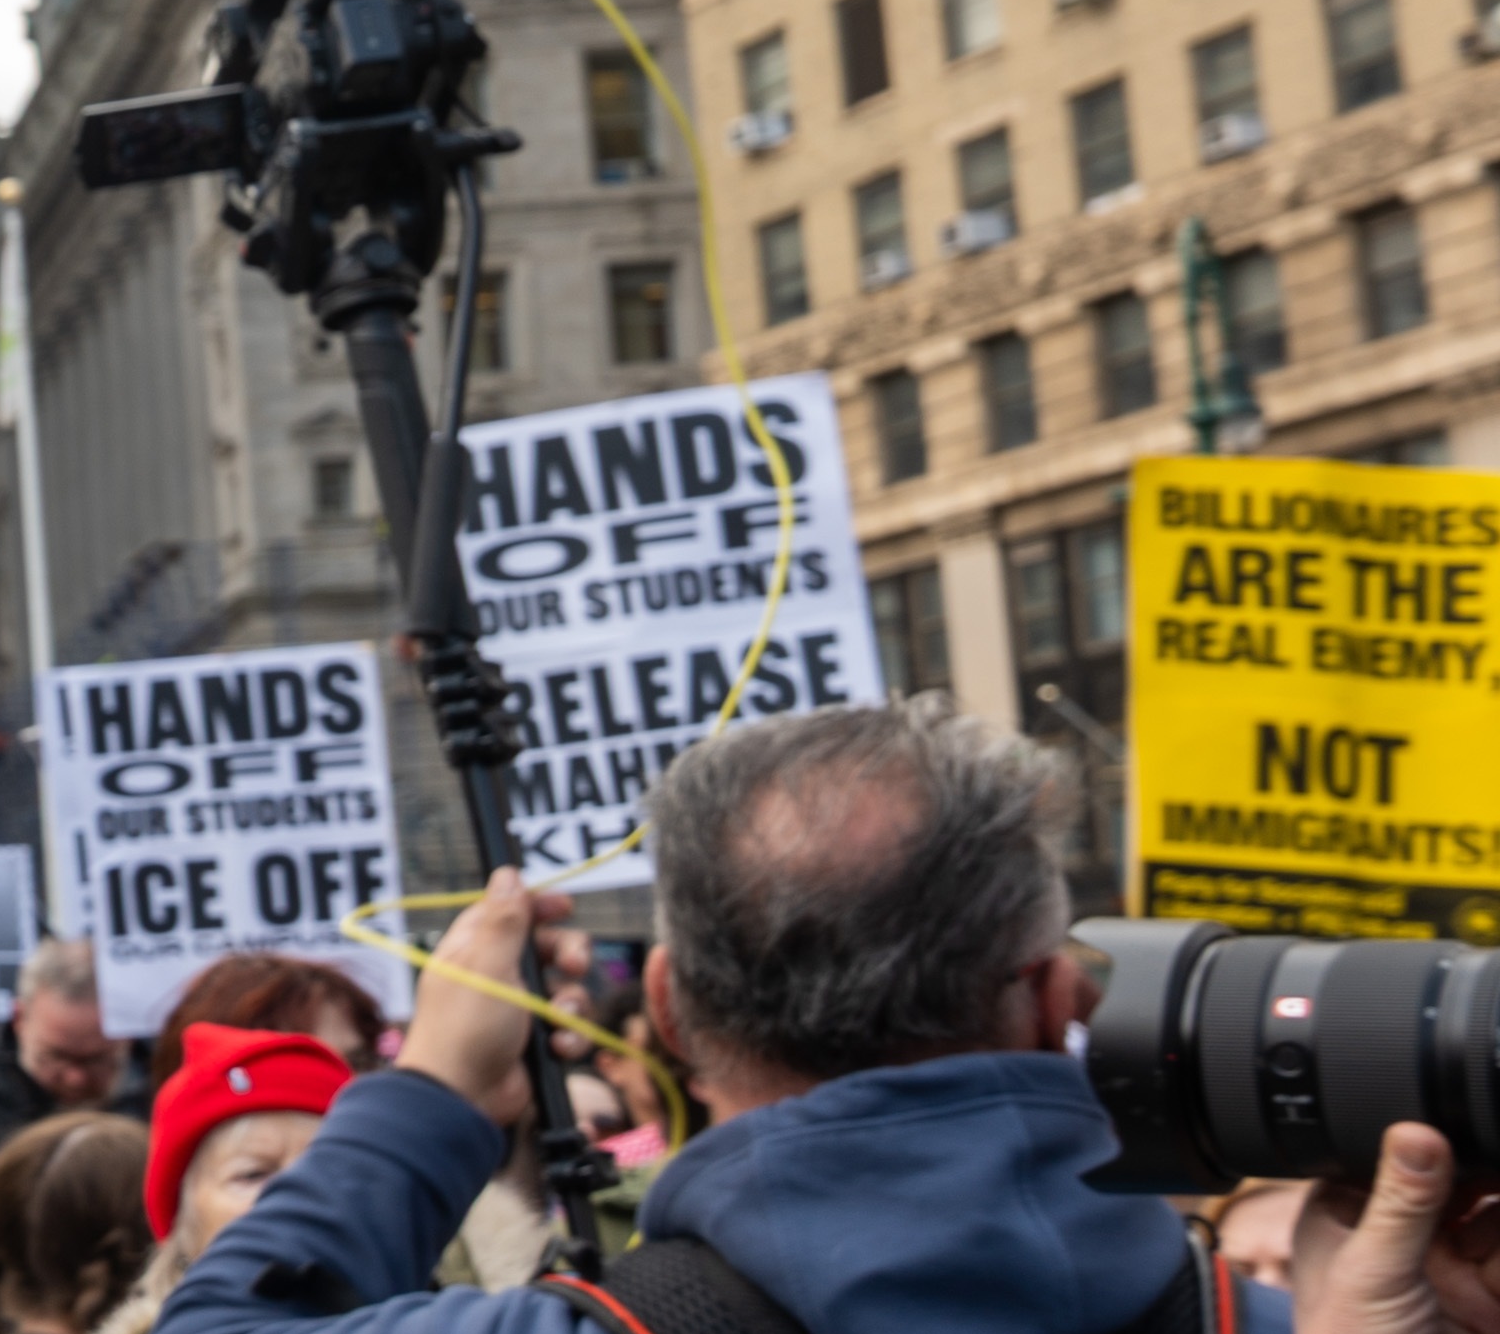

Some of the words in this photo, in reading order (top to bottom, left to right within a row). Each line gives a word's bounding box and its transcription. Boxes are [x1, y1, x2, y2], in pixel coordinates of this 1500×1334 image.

[466, 401, 807, 534] HANDS
[476, 496, 809, 581] OFF
[1158, 486, 1500, 547] BILLIONAIRES
[476, 590, 566, 636] OUR
[585, 551, 830, 620] STUDENTS
[1175, 545, 1326, 611] ARE
[1346, 557, 1484, 624] THE
[1155, 620, 1290, 668] REAL
[87, 663, 364, 755] HANDS
[504, 632, 849, 748] RELEASE
[99, 744, 364, 797] OFF
[1255, 722, 1408, 806] NOT
[100, 806, 168, 840] OUR
[187, 790, 377, 833] STUDENTS
[106, 862, 225, 936] ICE
[255, 847, 384, 925] OFF
